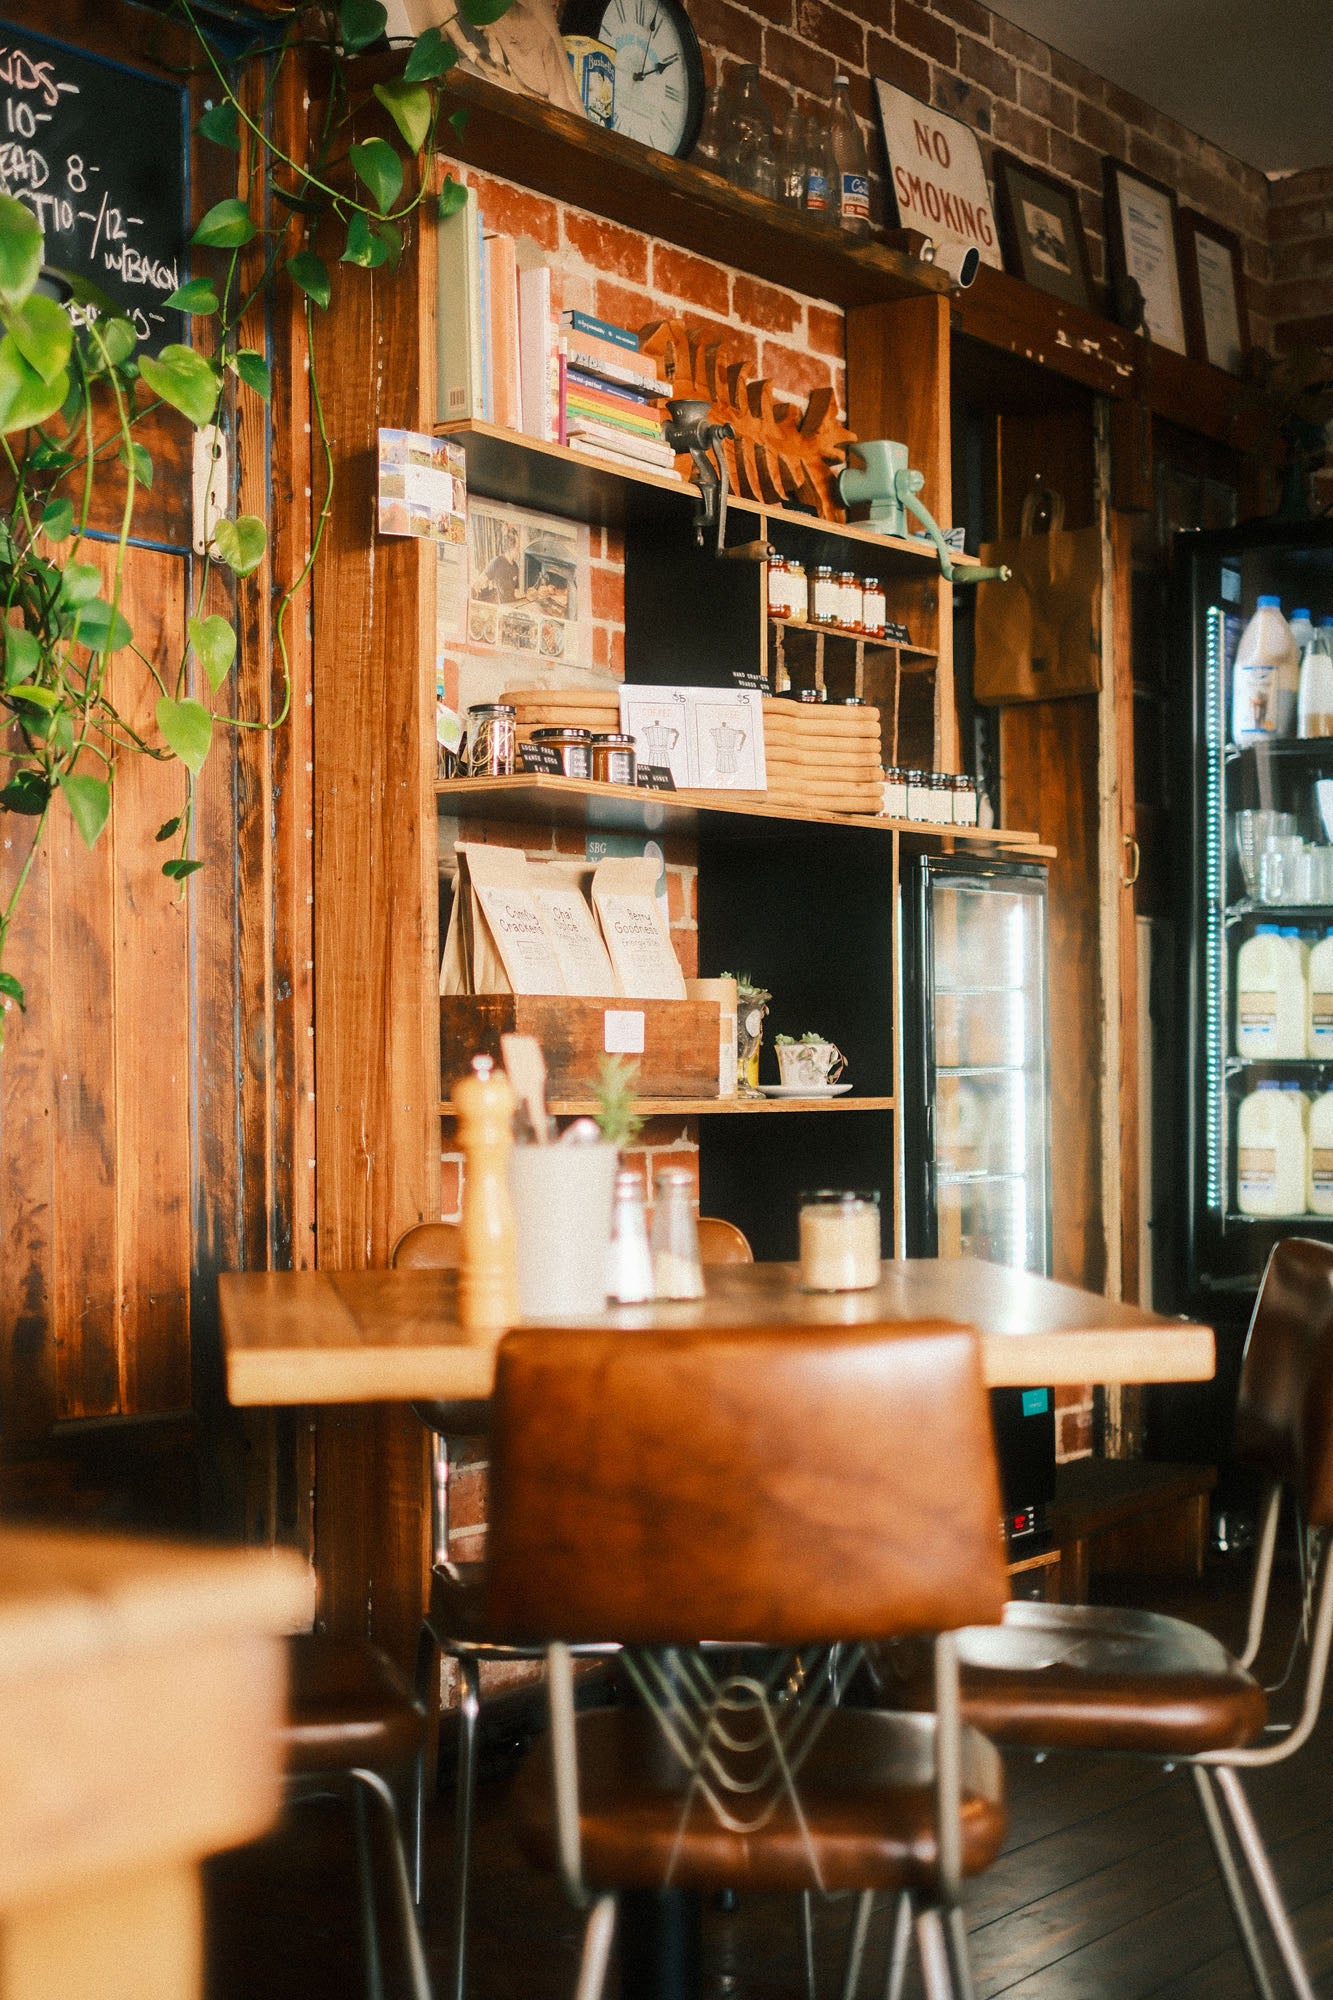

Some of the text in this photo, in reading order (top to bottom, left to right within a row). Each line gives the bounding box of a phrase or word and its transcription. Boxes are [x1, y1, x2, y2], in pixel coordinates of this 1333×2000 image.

[914, 119, 950, 169] NO
[895, 166, 992, 246] SMOKING
[589, 841, 607, 854] SBG
[627, 908, 652, 926] Berry
[615, 921, 659, 936] Goodness
